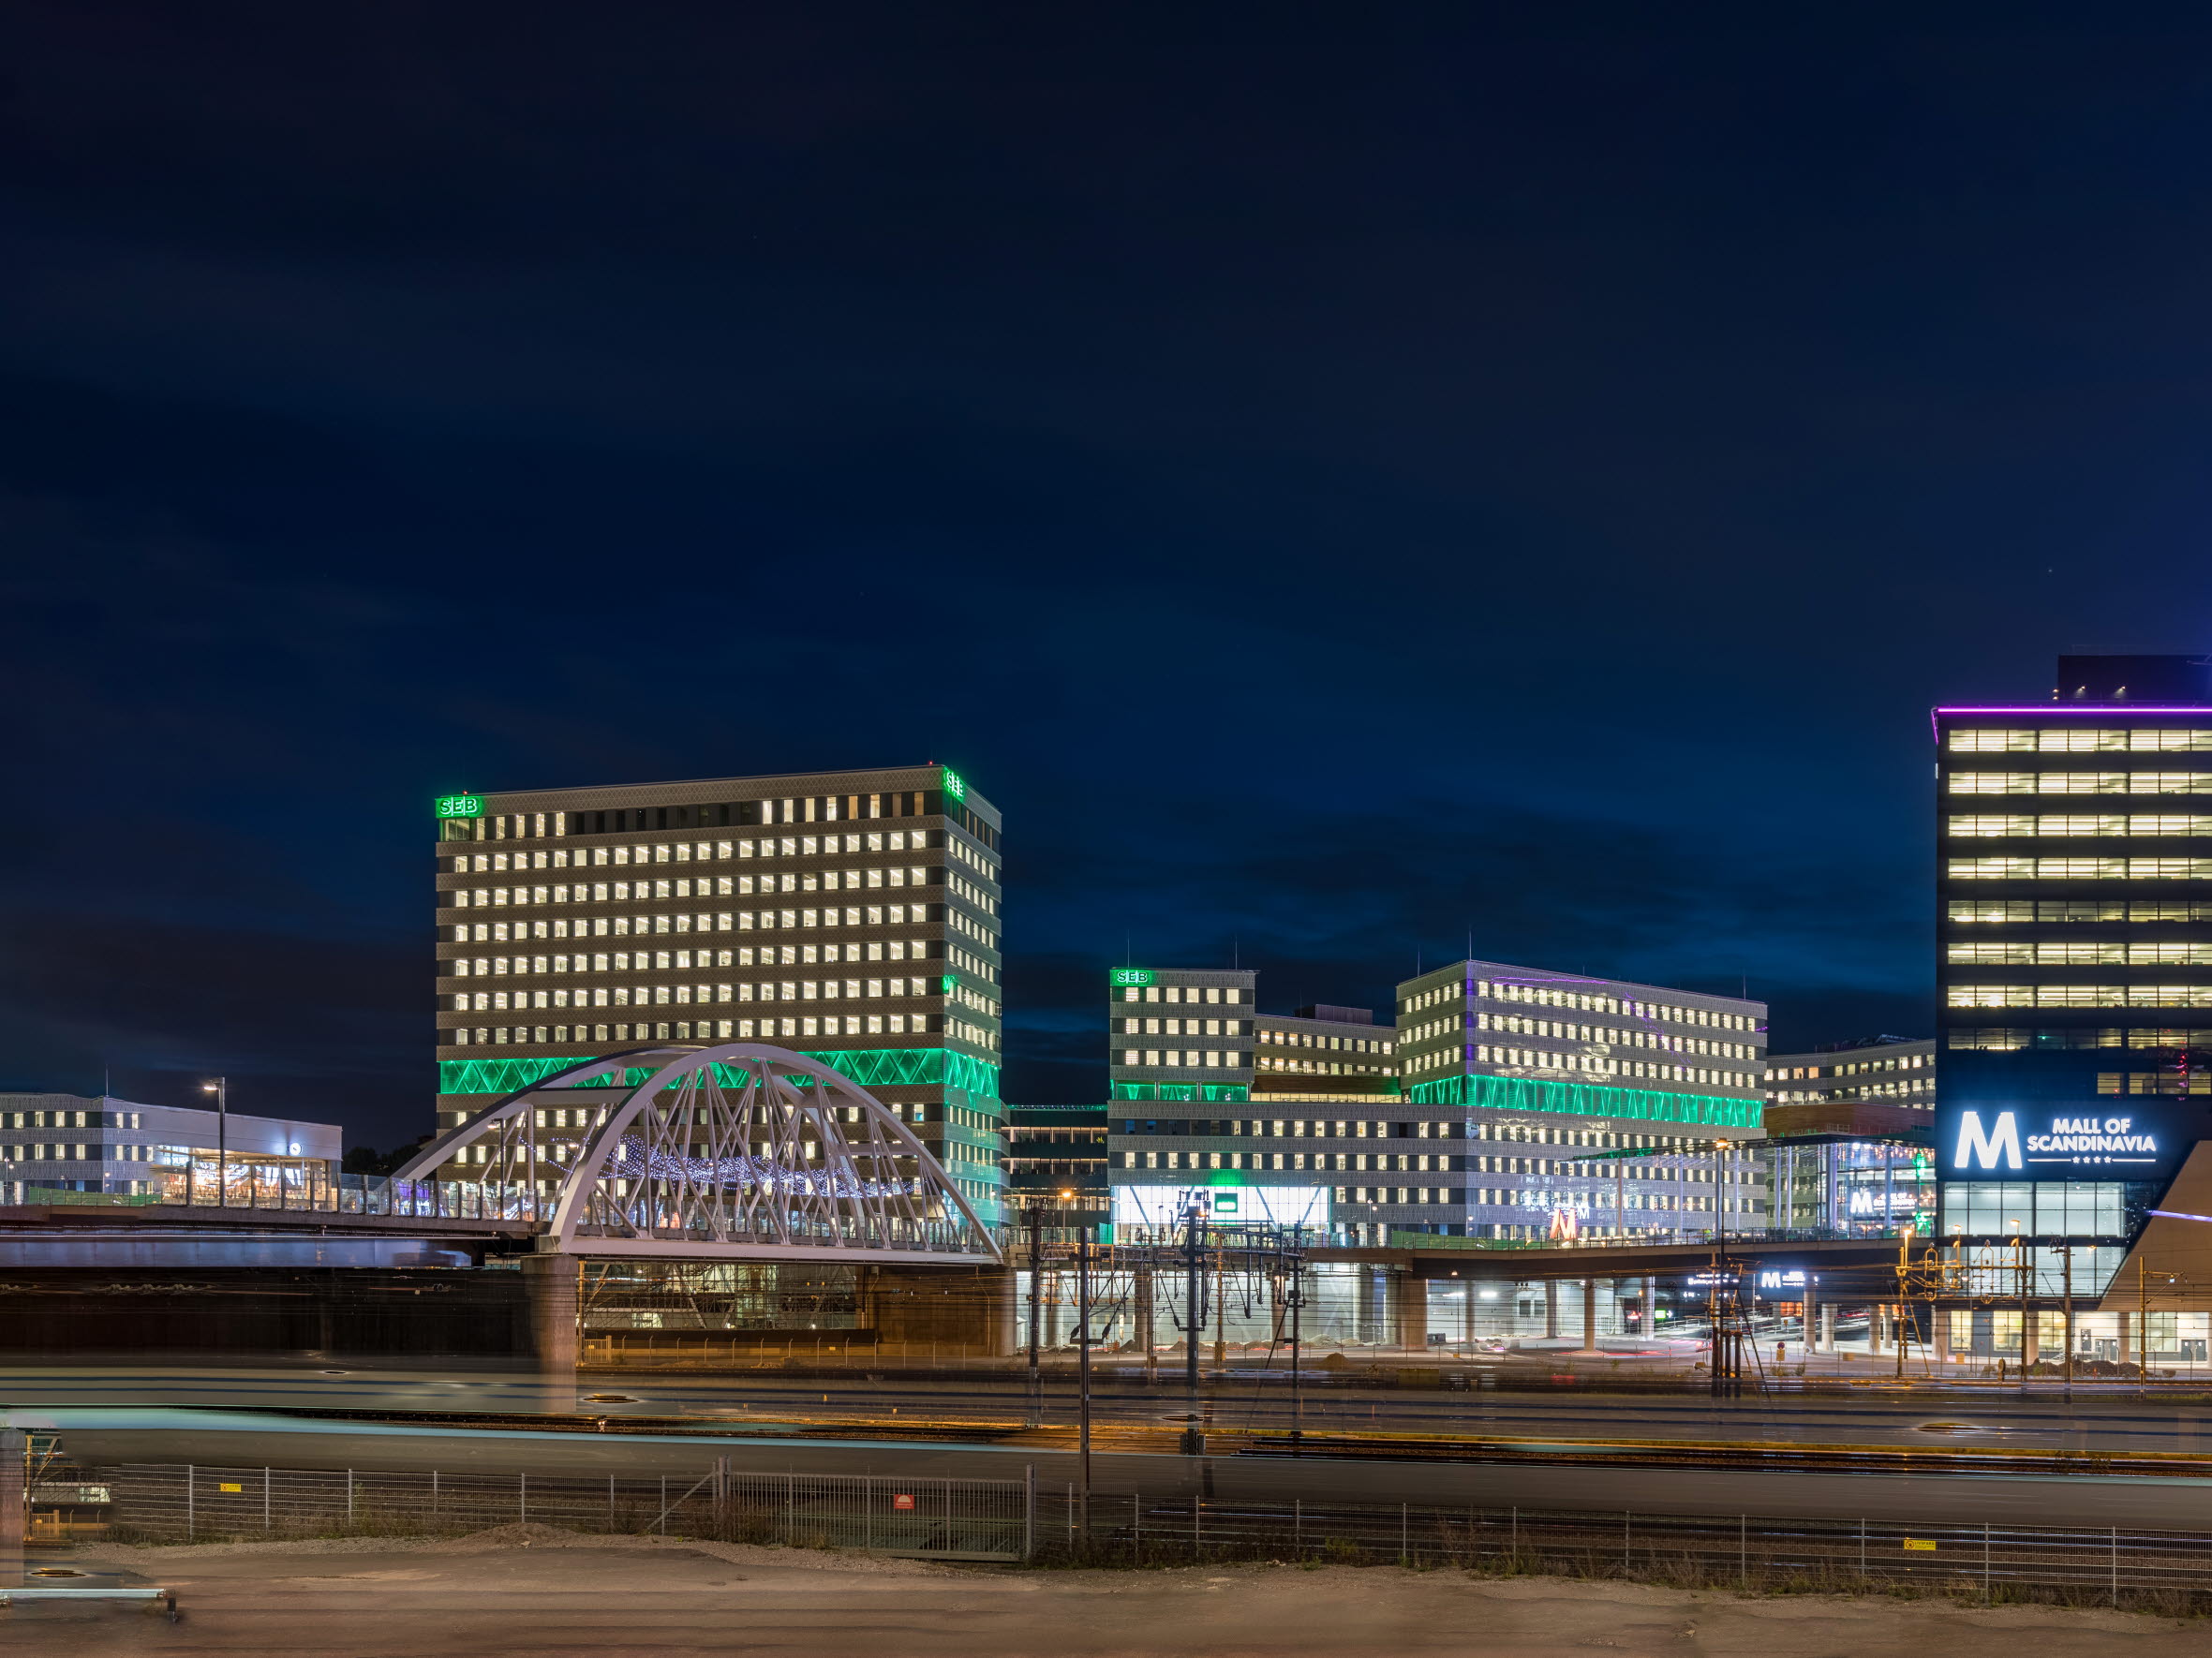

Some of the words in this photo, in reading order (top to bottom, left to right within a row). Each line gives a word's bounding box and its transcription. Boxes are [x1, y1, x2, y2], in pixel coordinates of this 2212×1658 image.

[943, 771, 963, 796] SEB
[439, 797, 478, 816] SEB
[1117, 970, 1148, 984] SEB
[2052, 1118, 2101, 1134] MALL
[2104, 1118, 2130, 1134] OF
[1953, 1111, 2023, 1169] M
[2026, 1135, 2157, 1152] SCANDINAVIA
[1849, 1192, 1873, 1213] M
[1761, 1271, 1782, 1288] M
